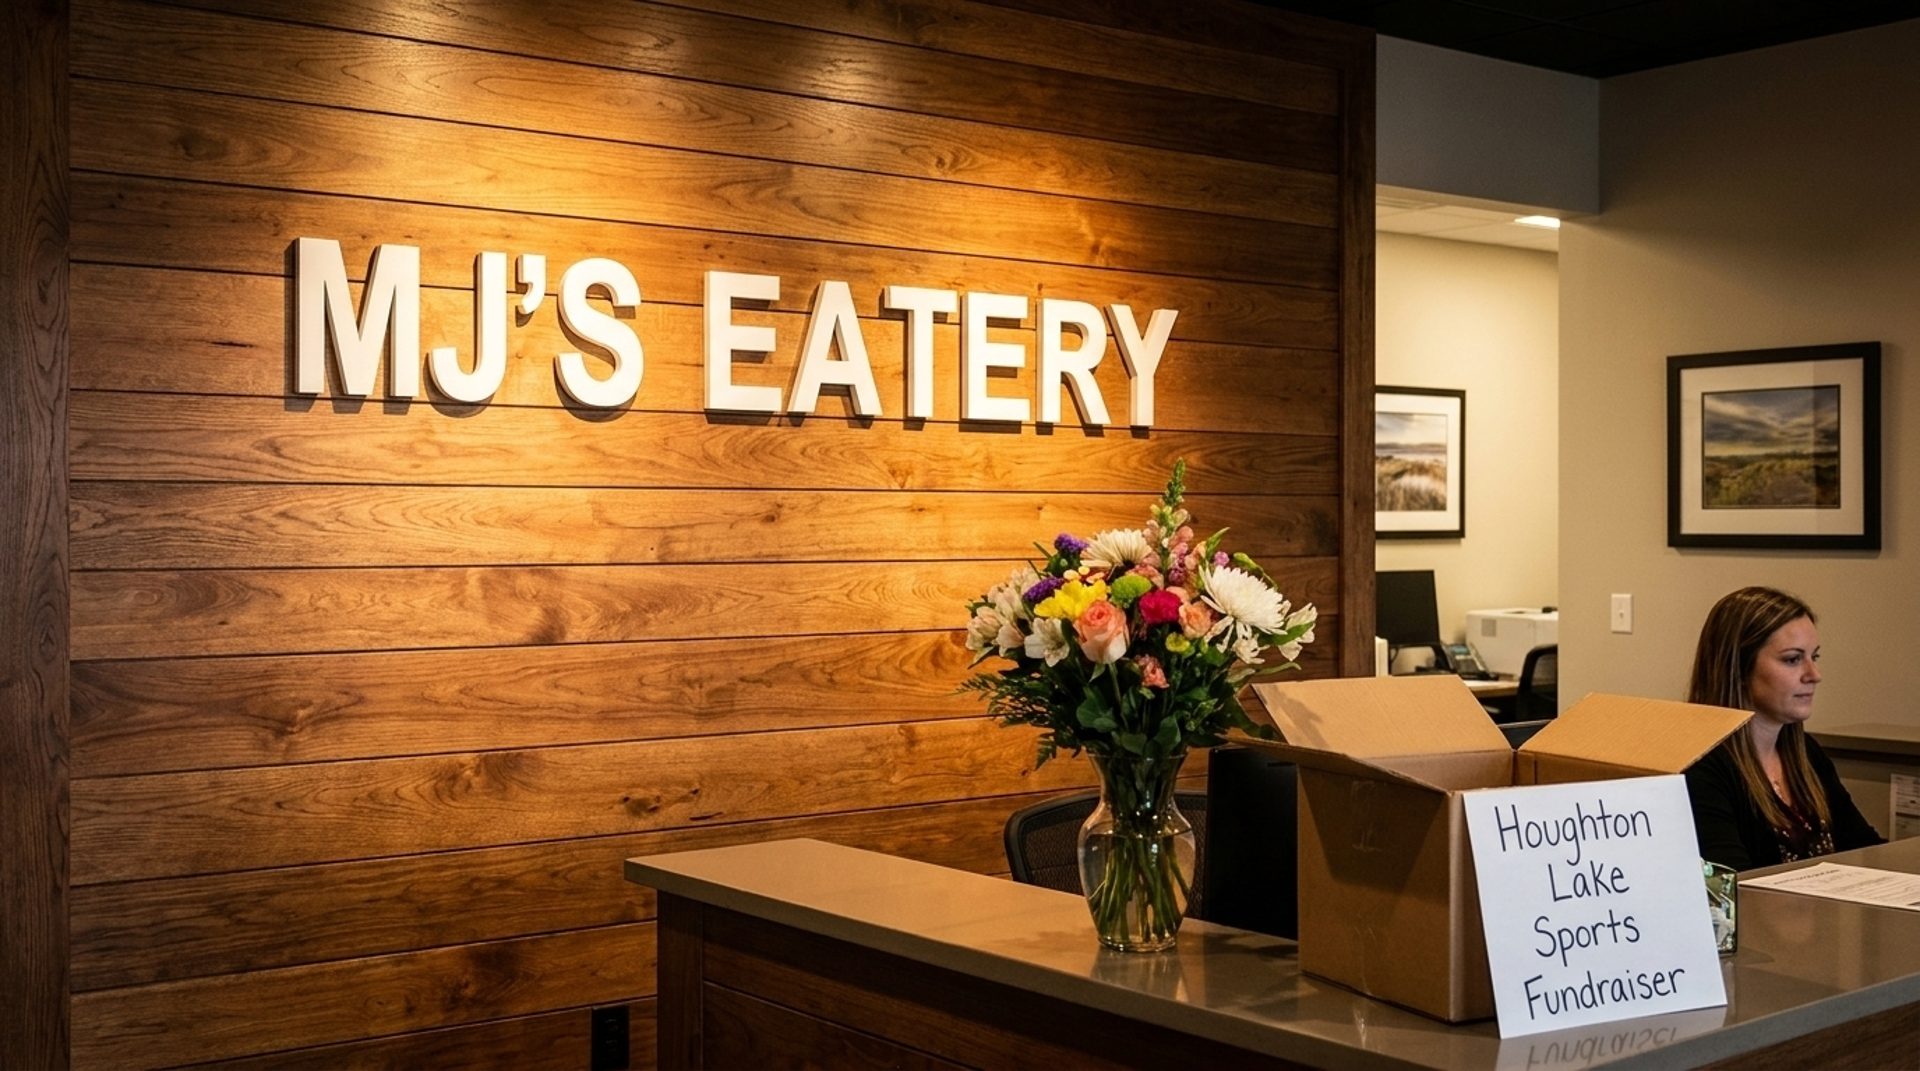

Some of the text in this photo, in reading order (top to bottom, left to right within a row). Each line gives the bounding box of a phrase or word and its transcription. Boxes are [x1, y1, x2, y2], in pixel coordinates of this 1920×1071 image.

[703, 270, 1179, 428] EATERY
[1494, 798, 1652, 866] Houghton
[1548, 861, 1630, 902] Lake
[1534, 909, 1640, 967] Sports
[1524, 967, 1685, 1020] Fundraiser
